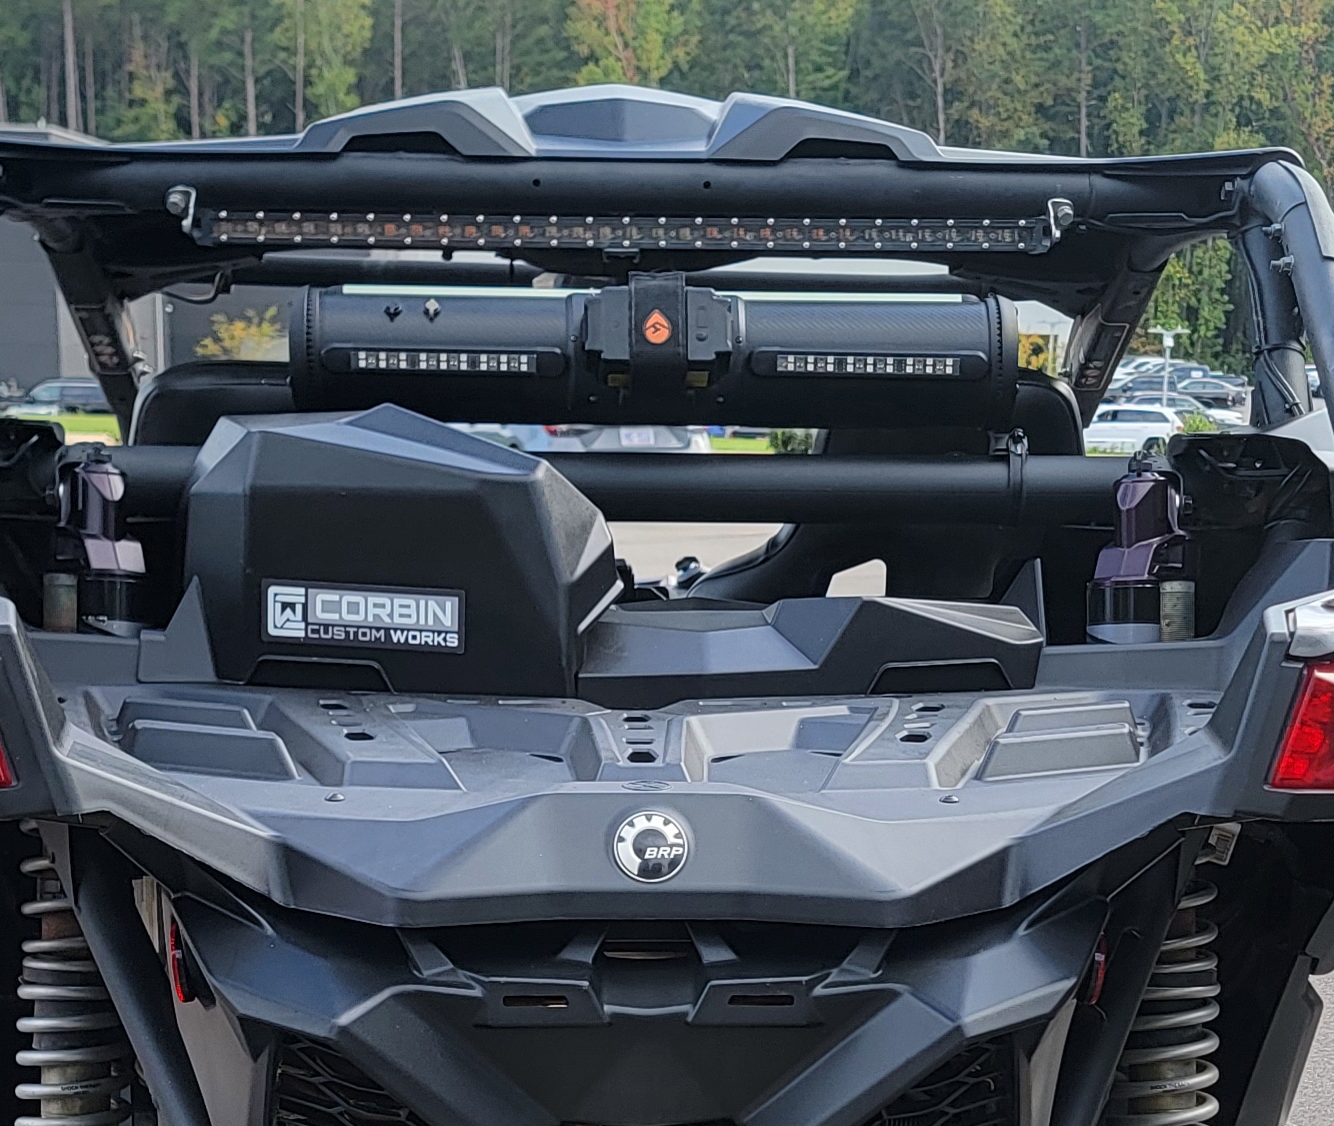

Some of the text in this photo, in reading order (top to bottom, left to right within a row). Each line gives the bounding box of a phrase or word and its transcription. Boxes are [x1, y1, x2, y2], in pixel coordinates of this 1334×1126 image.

[316, 593, 452, 627] CORBIN
[307, 625, 459, 647] CUSTOM WORKS
[644, 847, 684, 859] BRP
